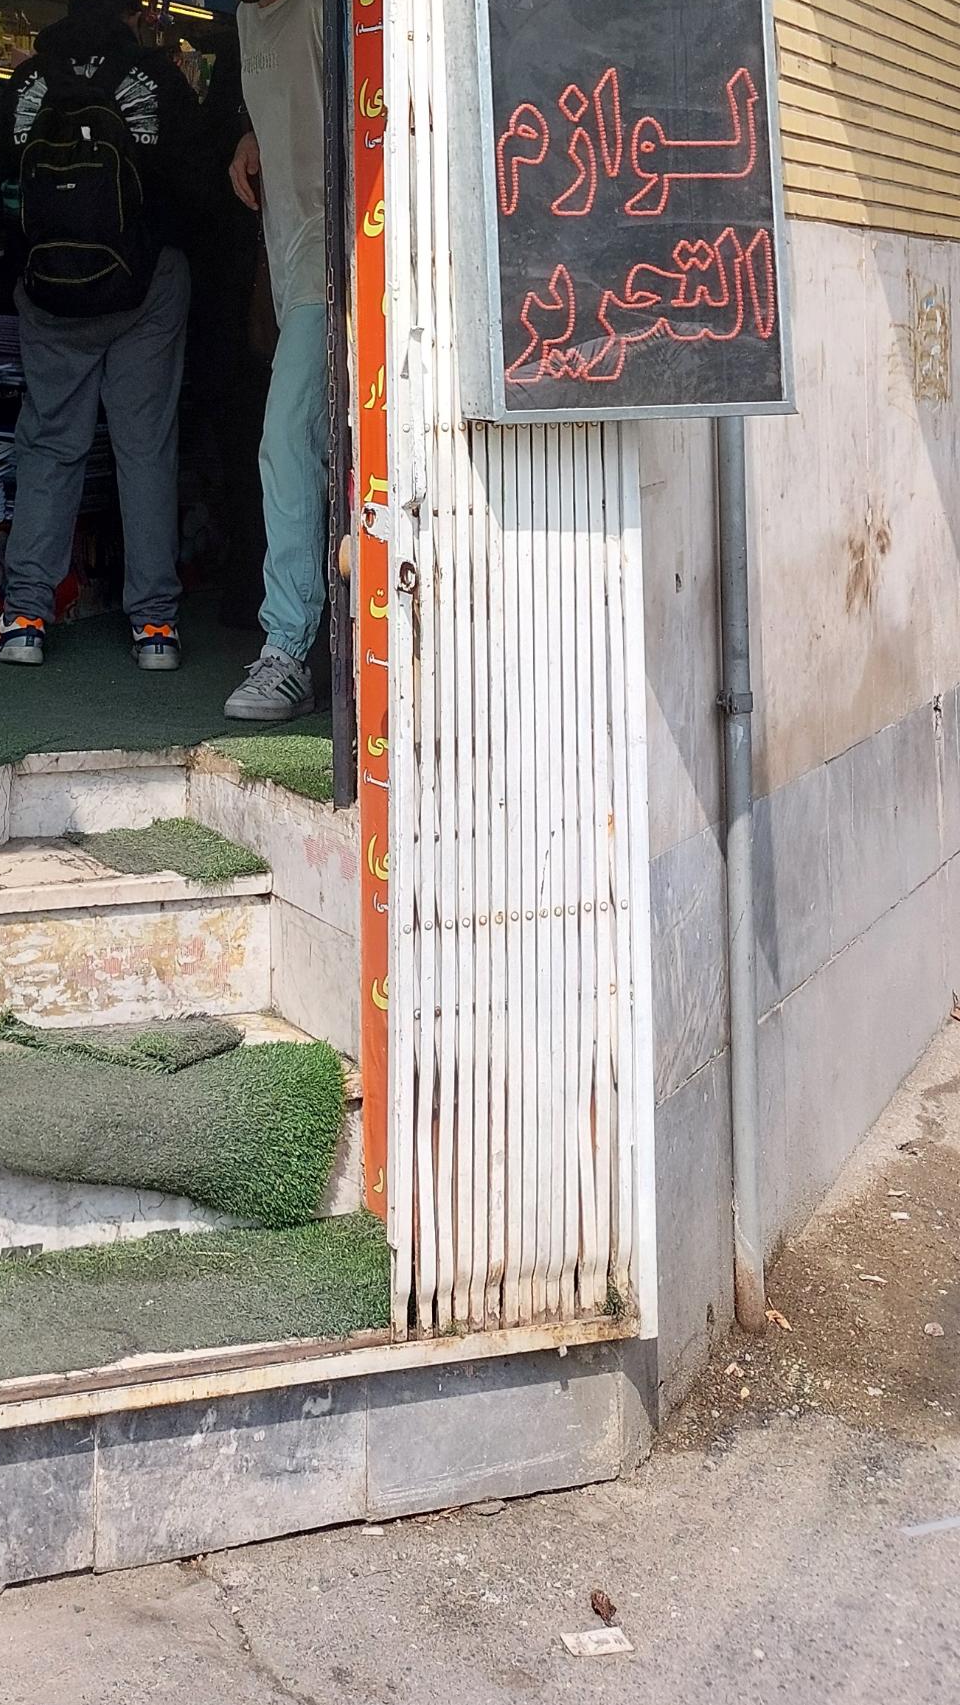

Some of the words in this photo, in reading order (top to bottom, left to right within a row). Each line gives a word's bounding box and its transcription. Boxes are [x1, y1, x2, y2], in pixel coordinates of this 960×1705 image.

[129, 66, 158, 91] SUN
[497, 67, 759, 216] لوازم
[504, 227, 775, 383] التحریر
